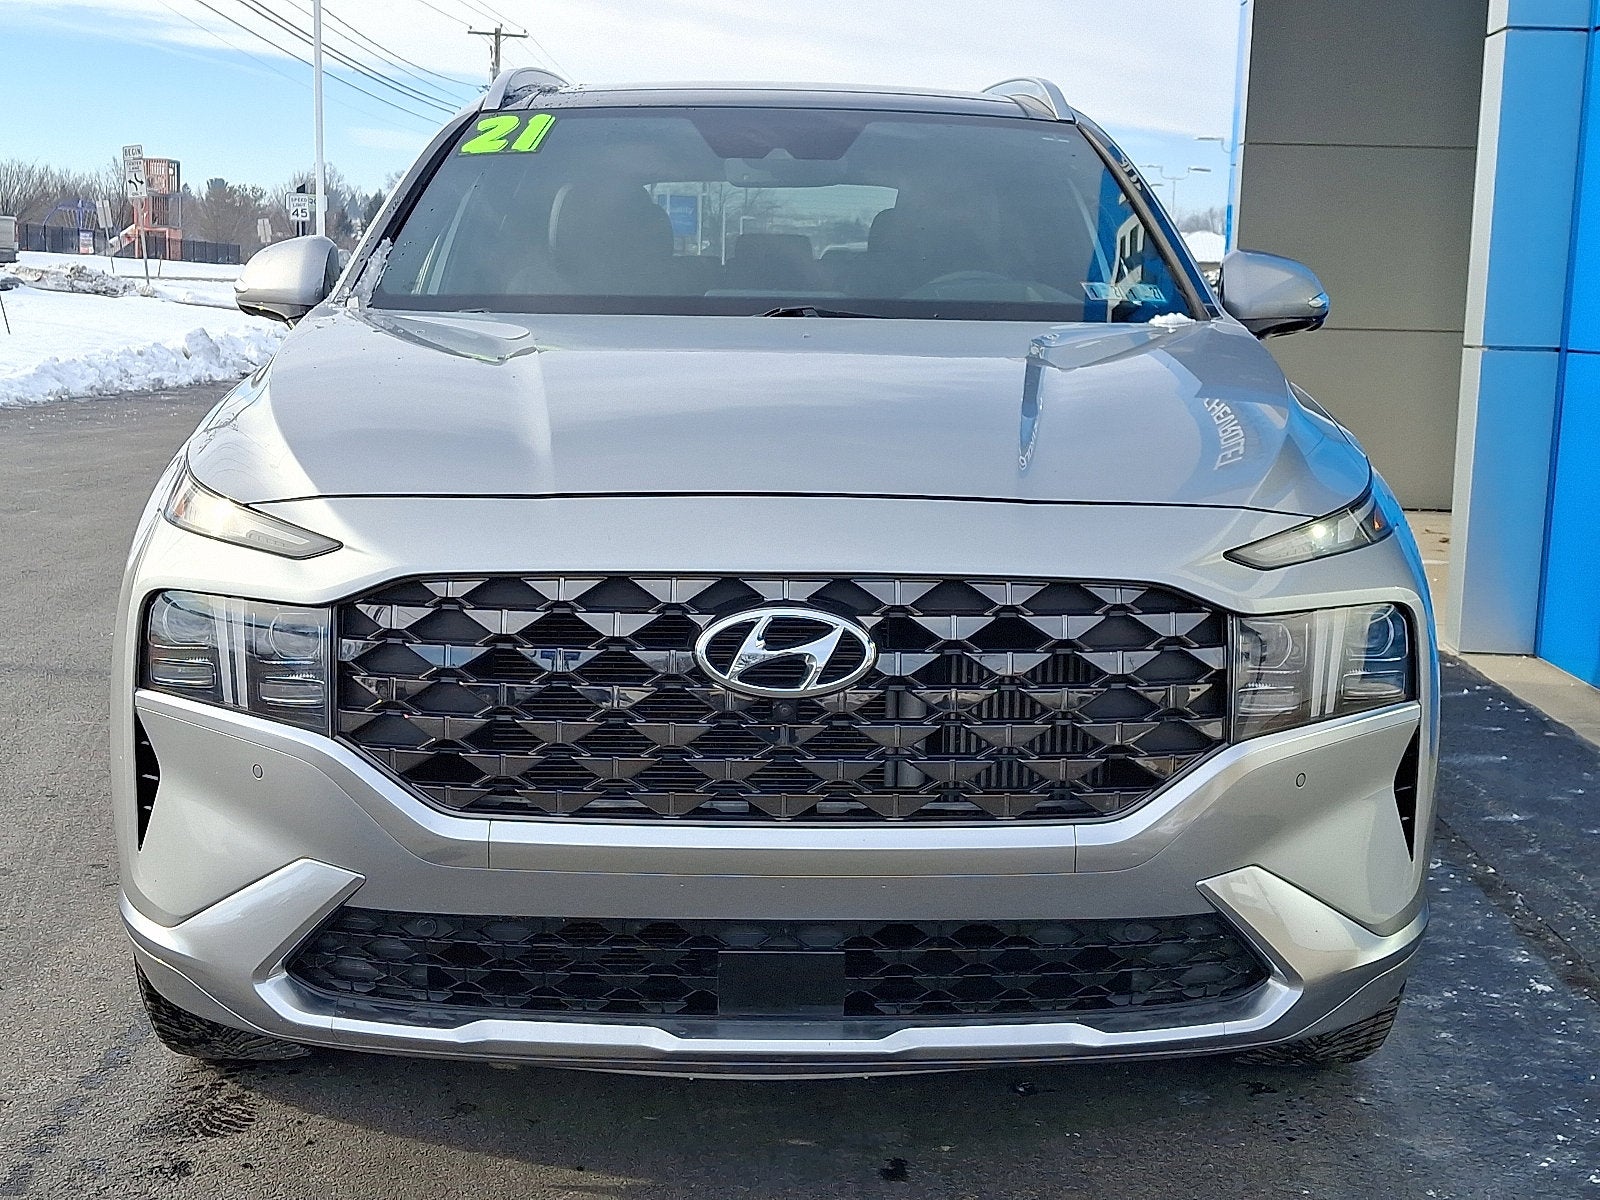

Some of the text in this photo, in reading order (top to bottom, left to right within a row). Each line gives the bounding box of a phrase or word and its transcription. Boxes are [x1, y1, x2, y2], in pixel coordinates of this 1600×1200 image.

[460, 113, 556, 153] 21
[124, 148, 142, 157] BEGIN
[291, 208, 308, 218] 45
